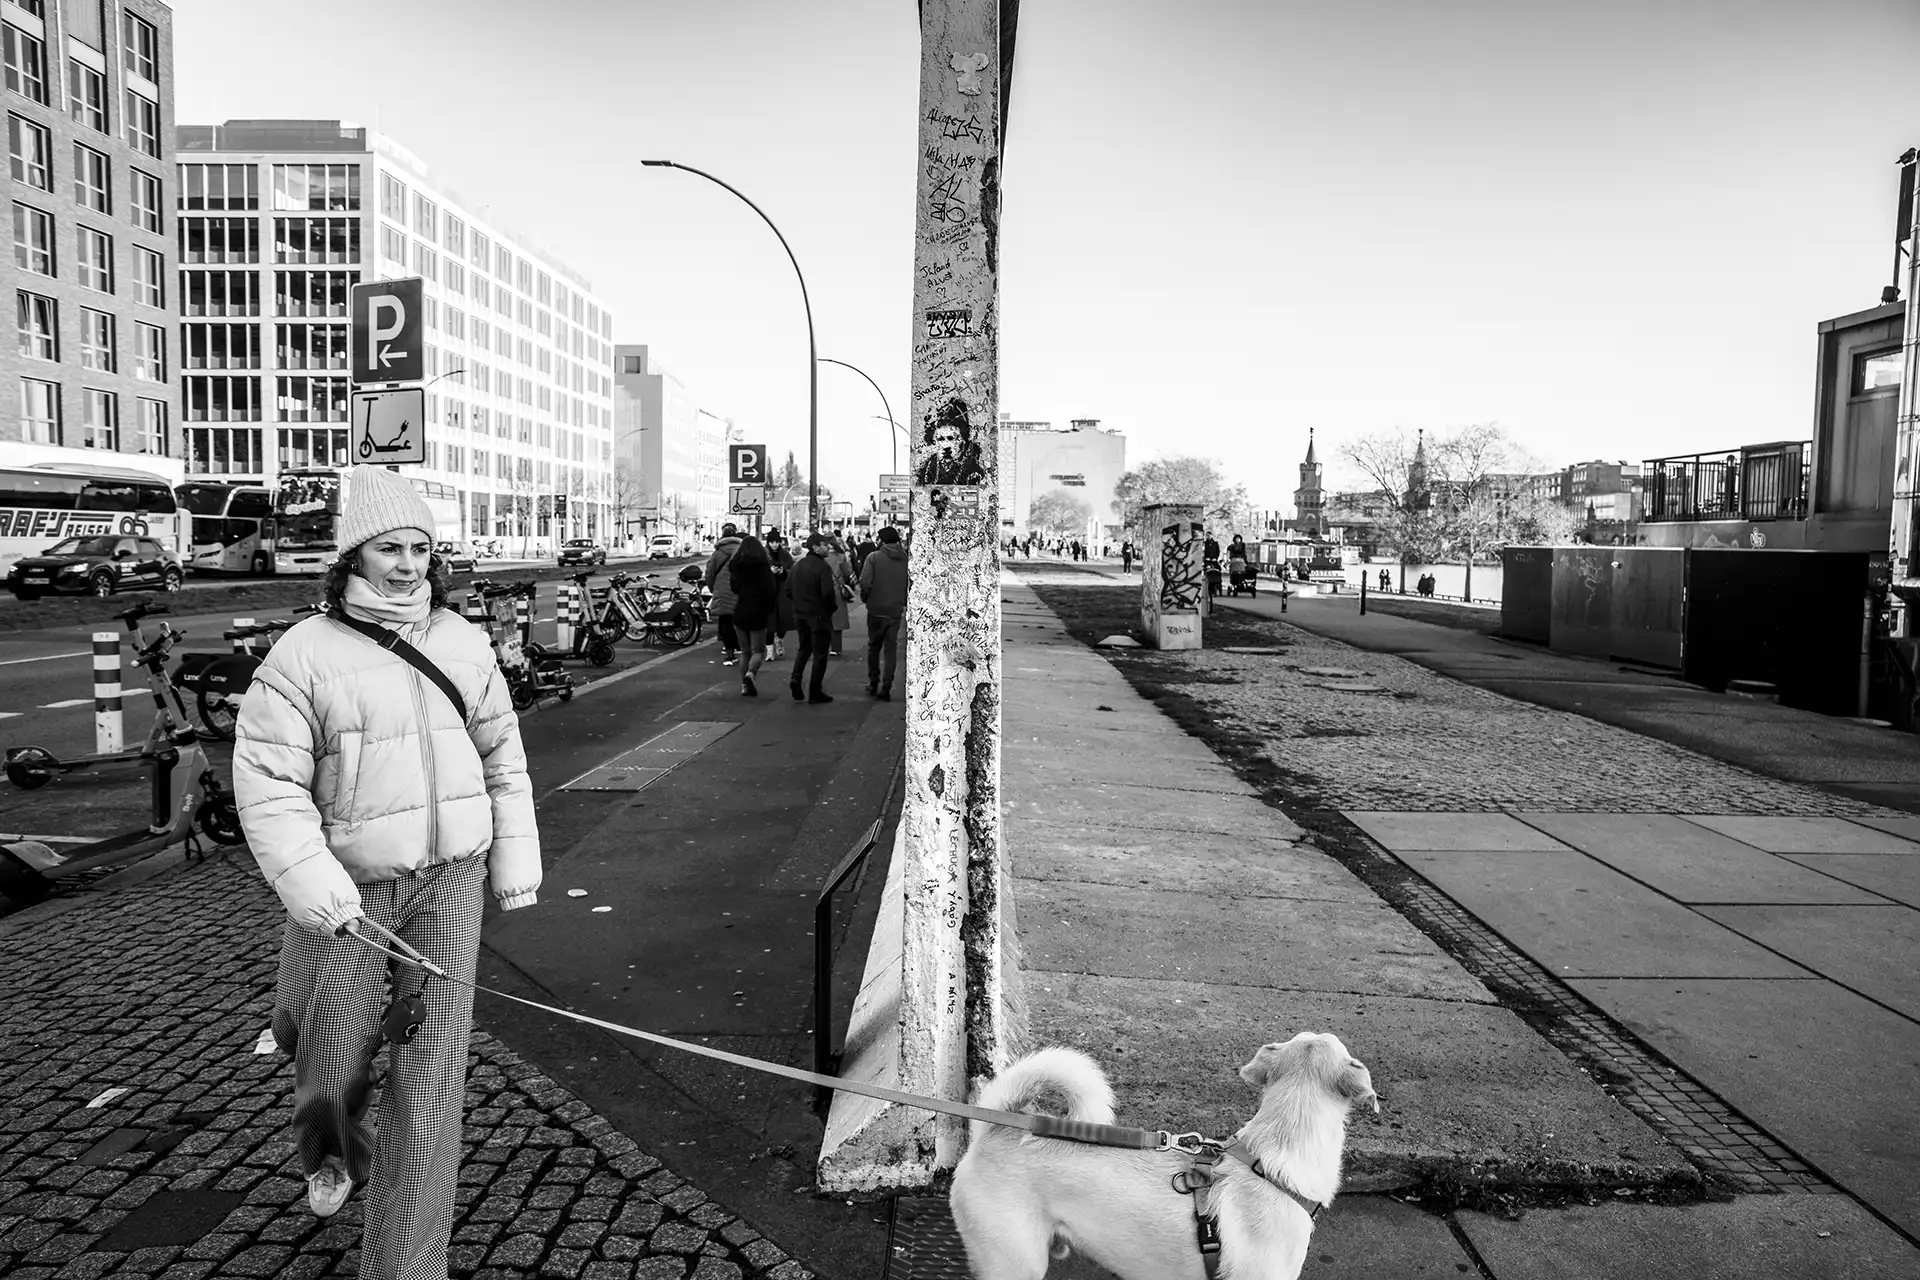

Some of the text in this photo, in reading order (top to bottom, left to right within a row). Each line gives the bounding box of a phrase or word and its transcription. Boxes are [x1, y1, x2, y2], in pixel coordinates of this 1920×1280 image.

[369, 294, 406, 370] P
[737, 449, 758, 479] P
[65, 524, 112, 538] REISEN
